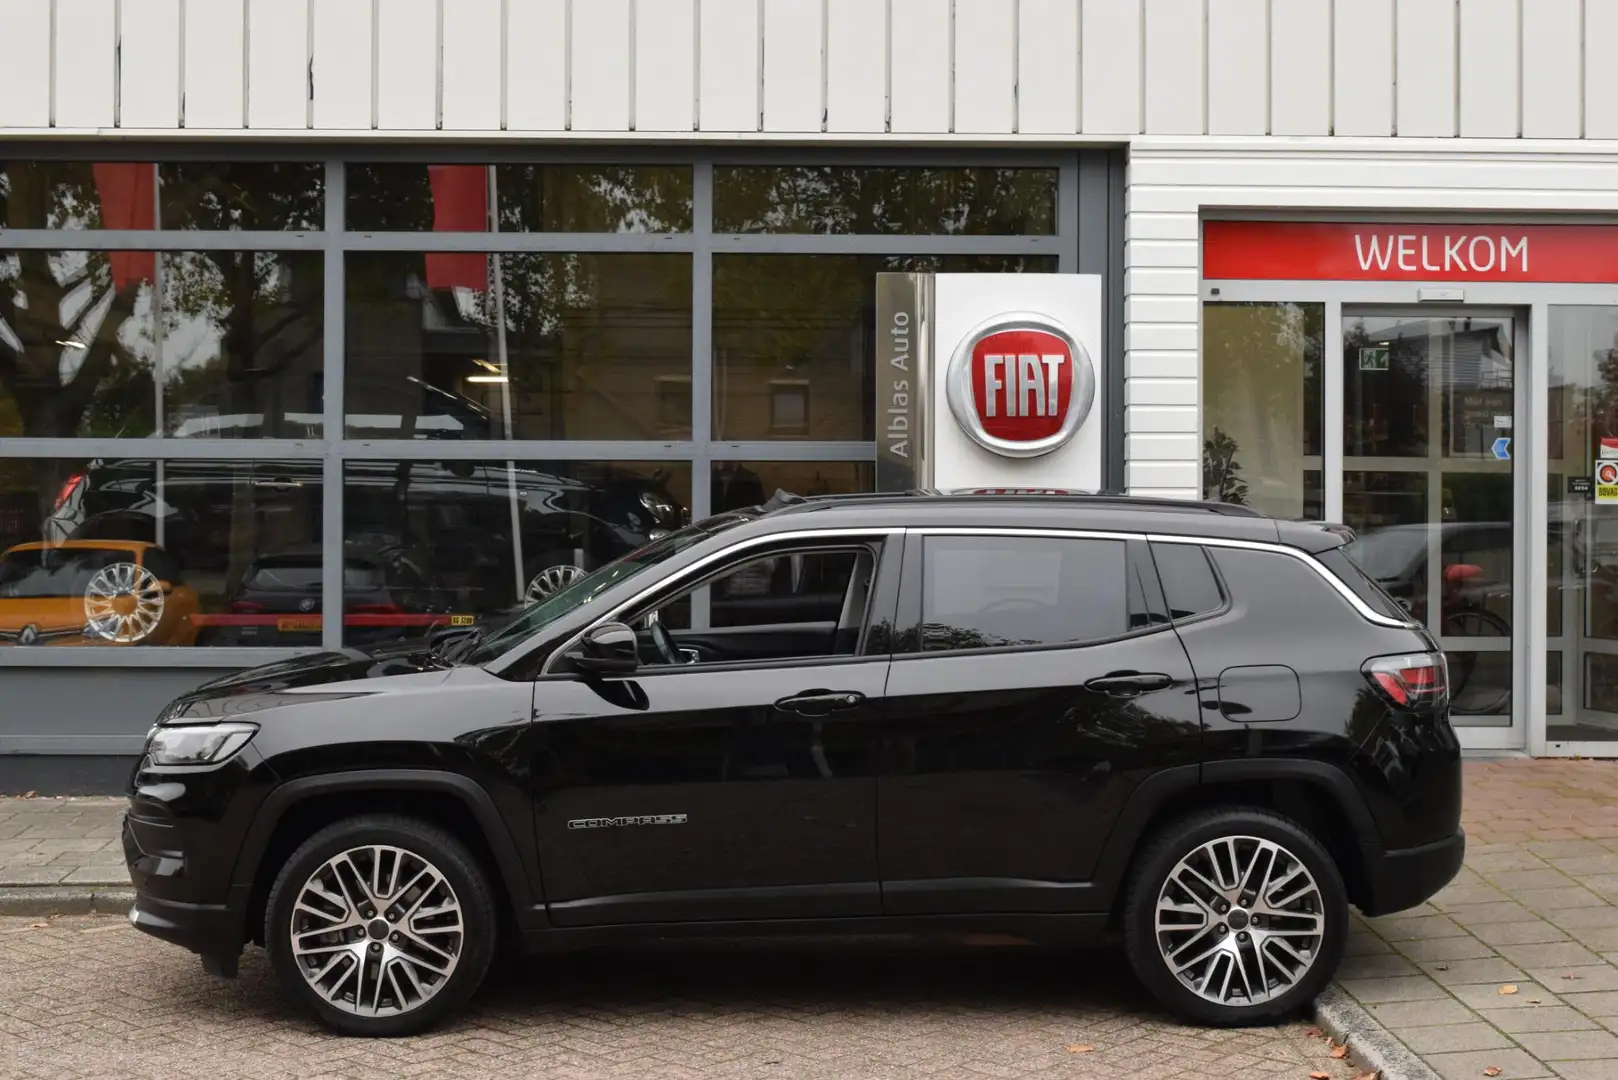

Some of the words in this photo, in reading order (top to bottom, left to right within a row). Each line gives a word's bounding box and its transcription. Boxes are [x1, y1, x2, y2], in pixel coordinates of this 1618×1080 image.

[1355, 234, 1528, 272] WELKOM
[890, 311, 910, 370] Auto
[984, 354, 1065, 417] FIAT
[887, 379, 909, 458] Alblas
[568, 814, 688, 829] COMPASS
